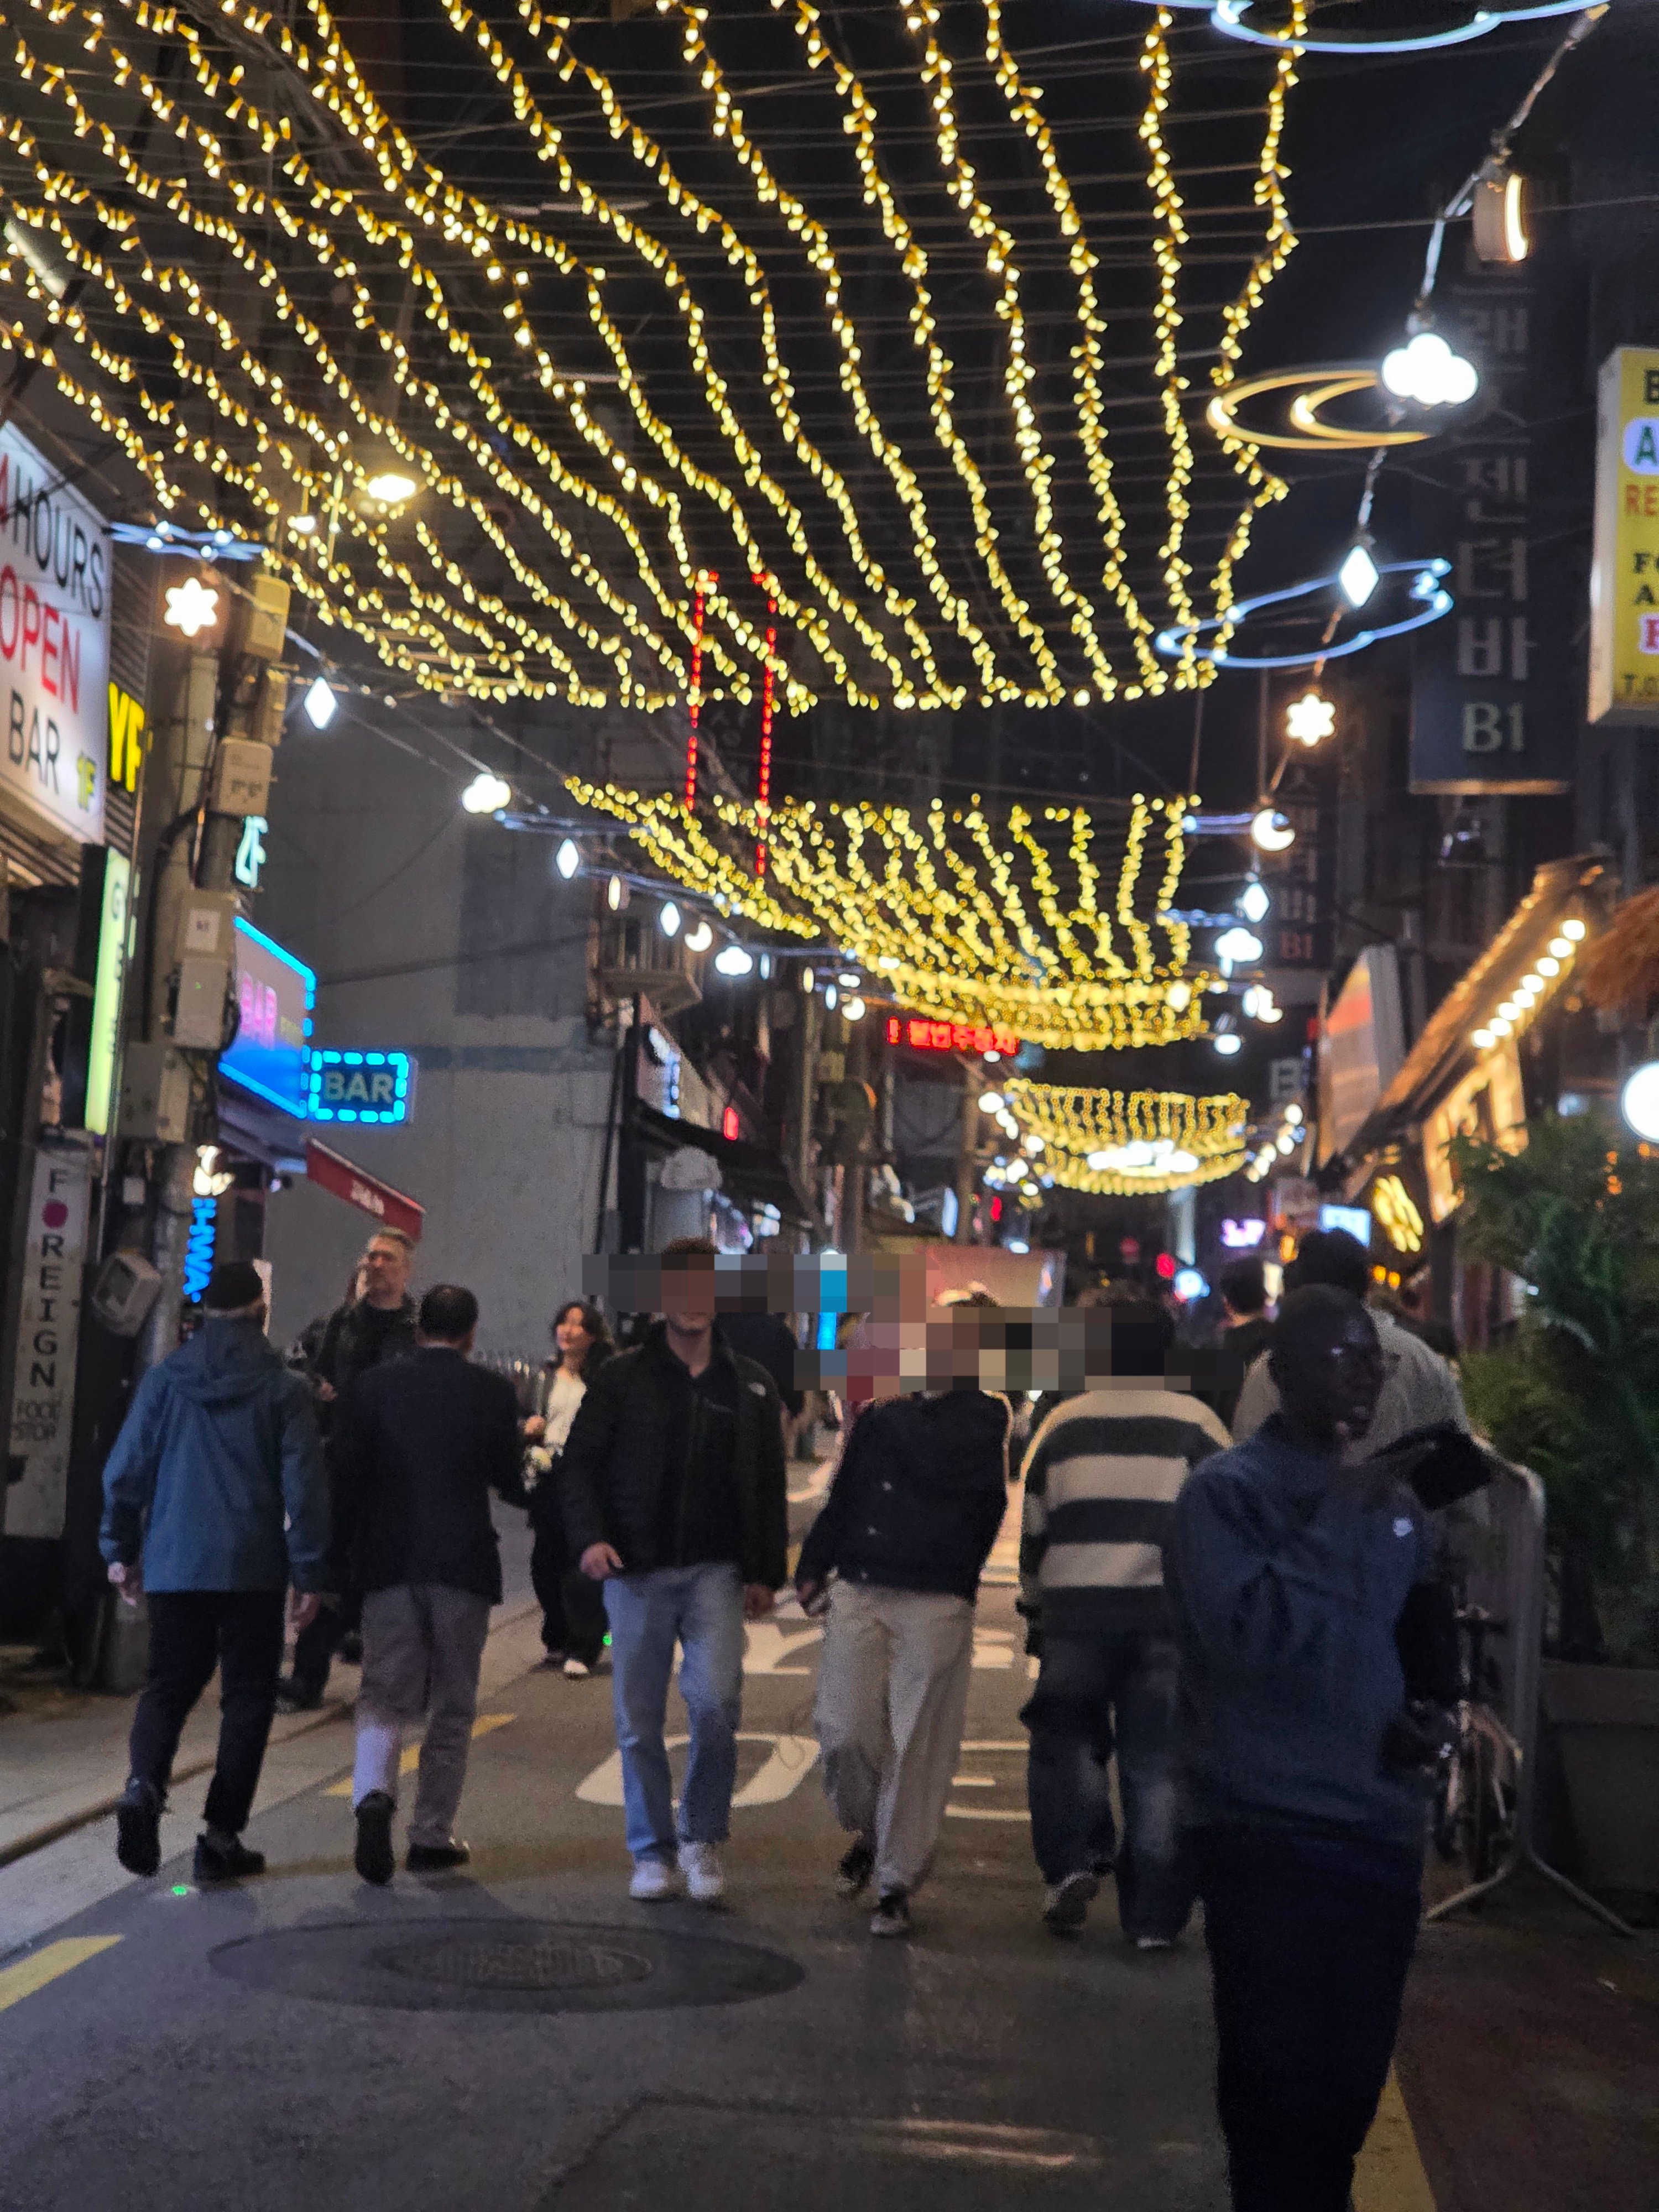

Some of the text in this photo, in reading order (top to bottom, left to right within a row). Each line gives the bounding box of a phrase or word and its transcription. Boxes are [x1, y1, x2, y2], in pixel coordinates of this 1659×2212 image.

[12, 465, 104, 619] HOURS
[0, 564, 80, 714] OPEN
[9, 688, 61, 795] BAR
[324, 1071, 394, 1103] BAR
